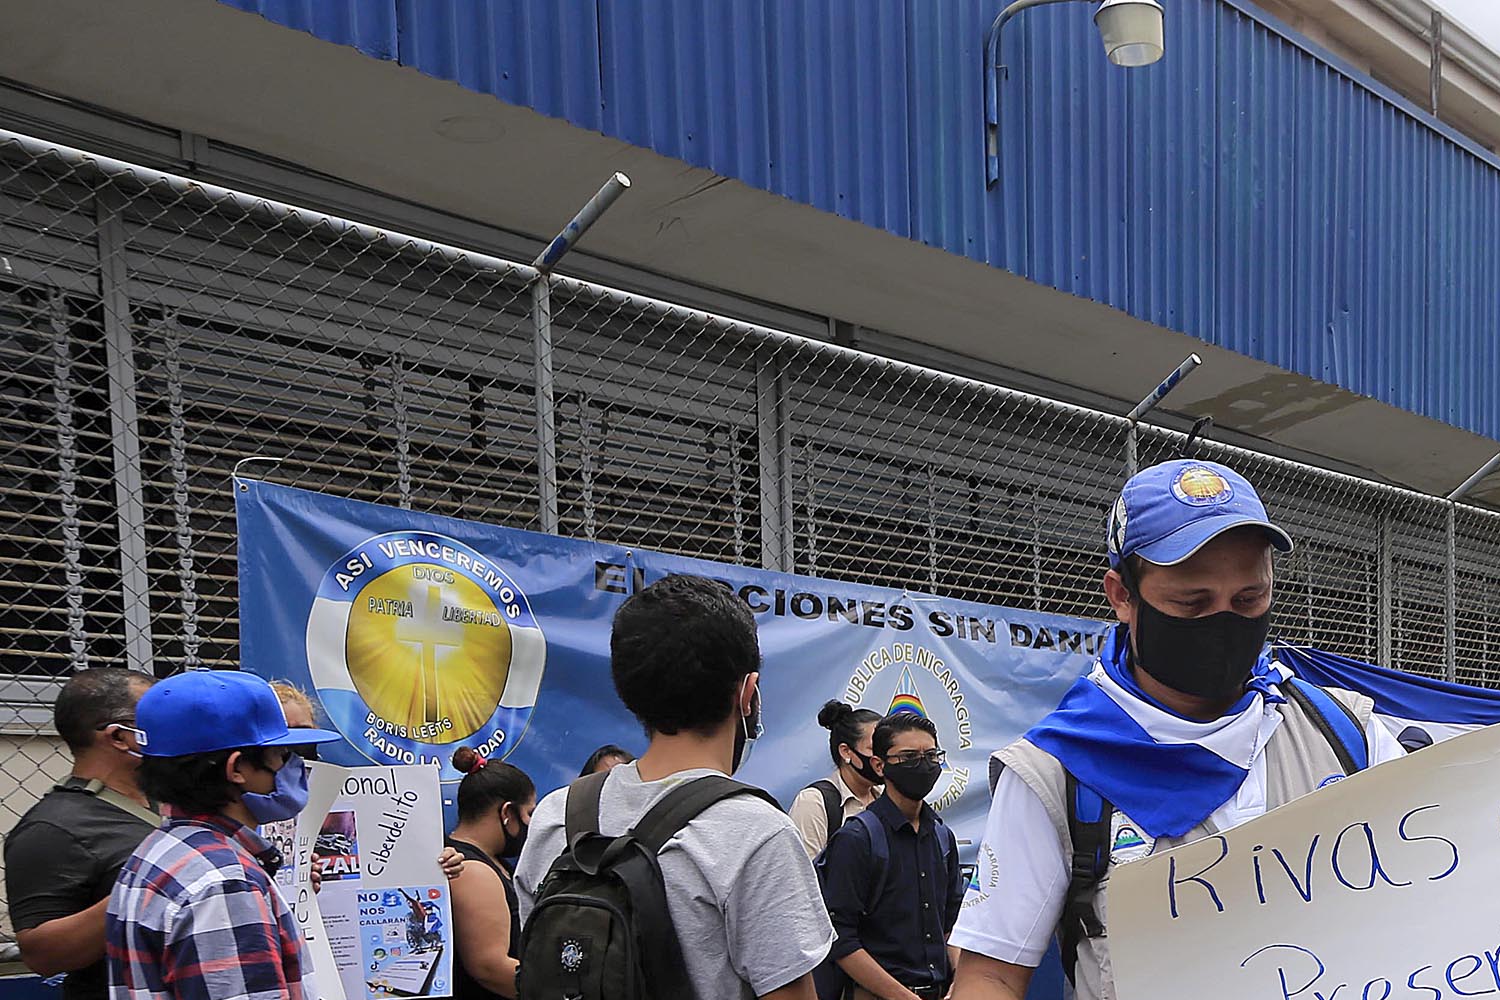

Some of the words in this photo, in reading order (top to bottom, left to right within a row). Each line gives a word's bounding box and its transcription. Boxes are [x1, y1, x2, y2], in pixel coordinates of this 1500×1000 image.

[334, 551, 374, 592] ASI
[378, 539, 522, 620] VENCEREMOS
[412, 565, 455, 584] DIOS
[367, 596, 414, 618] PATRIA
[441, 605, 501, 627] LIBERTAD
[594, 560, 916, 632] ELCIONES
[928, 610, 996, 643] SIN
[845, 647, 892, 704] UBLICA
[893, 644, 913, 662] DE
[916, 648, 971, 749] NICARAGUA
[365, 711, 408, 738] BORIS
[412, 718, 453, 739] LEETS
[363, 726, 416, 766] RADIO
[420, 754, 441, 769] LA
[928, 767, 970, 813] NTRAL
[367, 790, 419, 877] Ciberdelito
[1166, 803, 1460, 918] Rivas
[357, 892, 379, 903] NO
[360, 907, 385, 916] NOS
